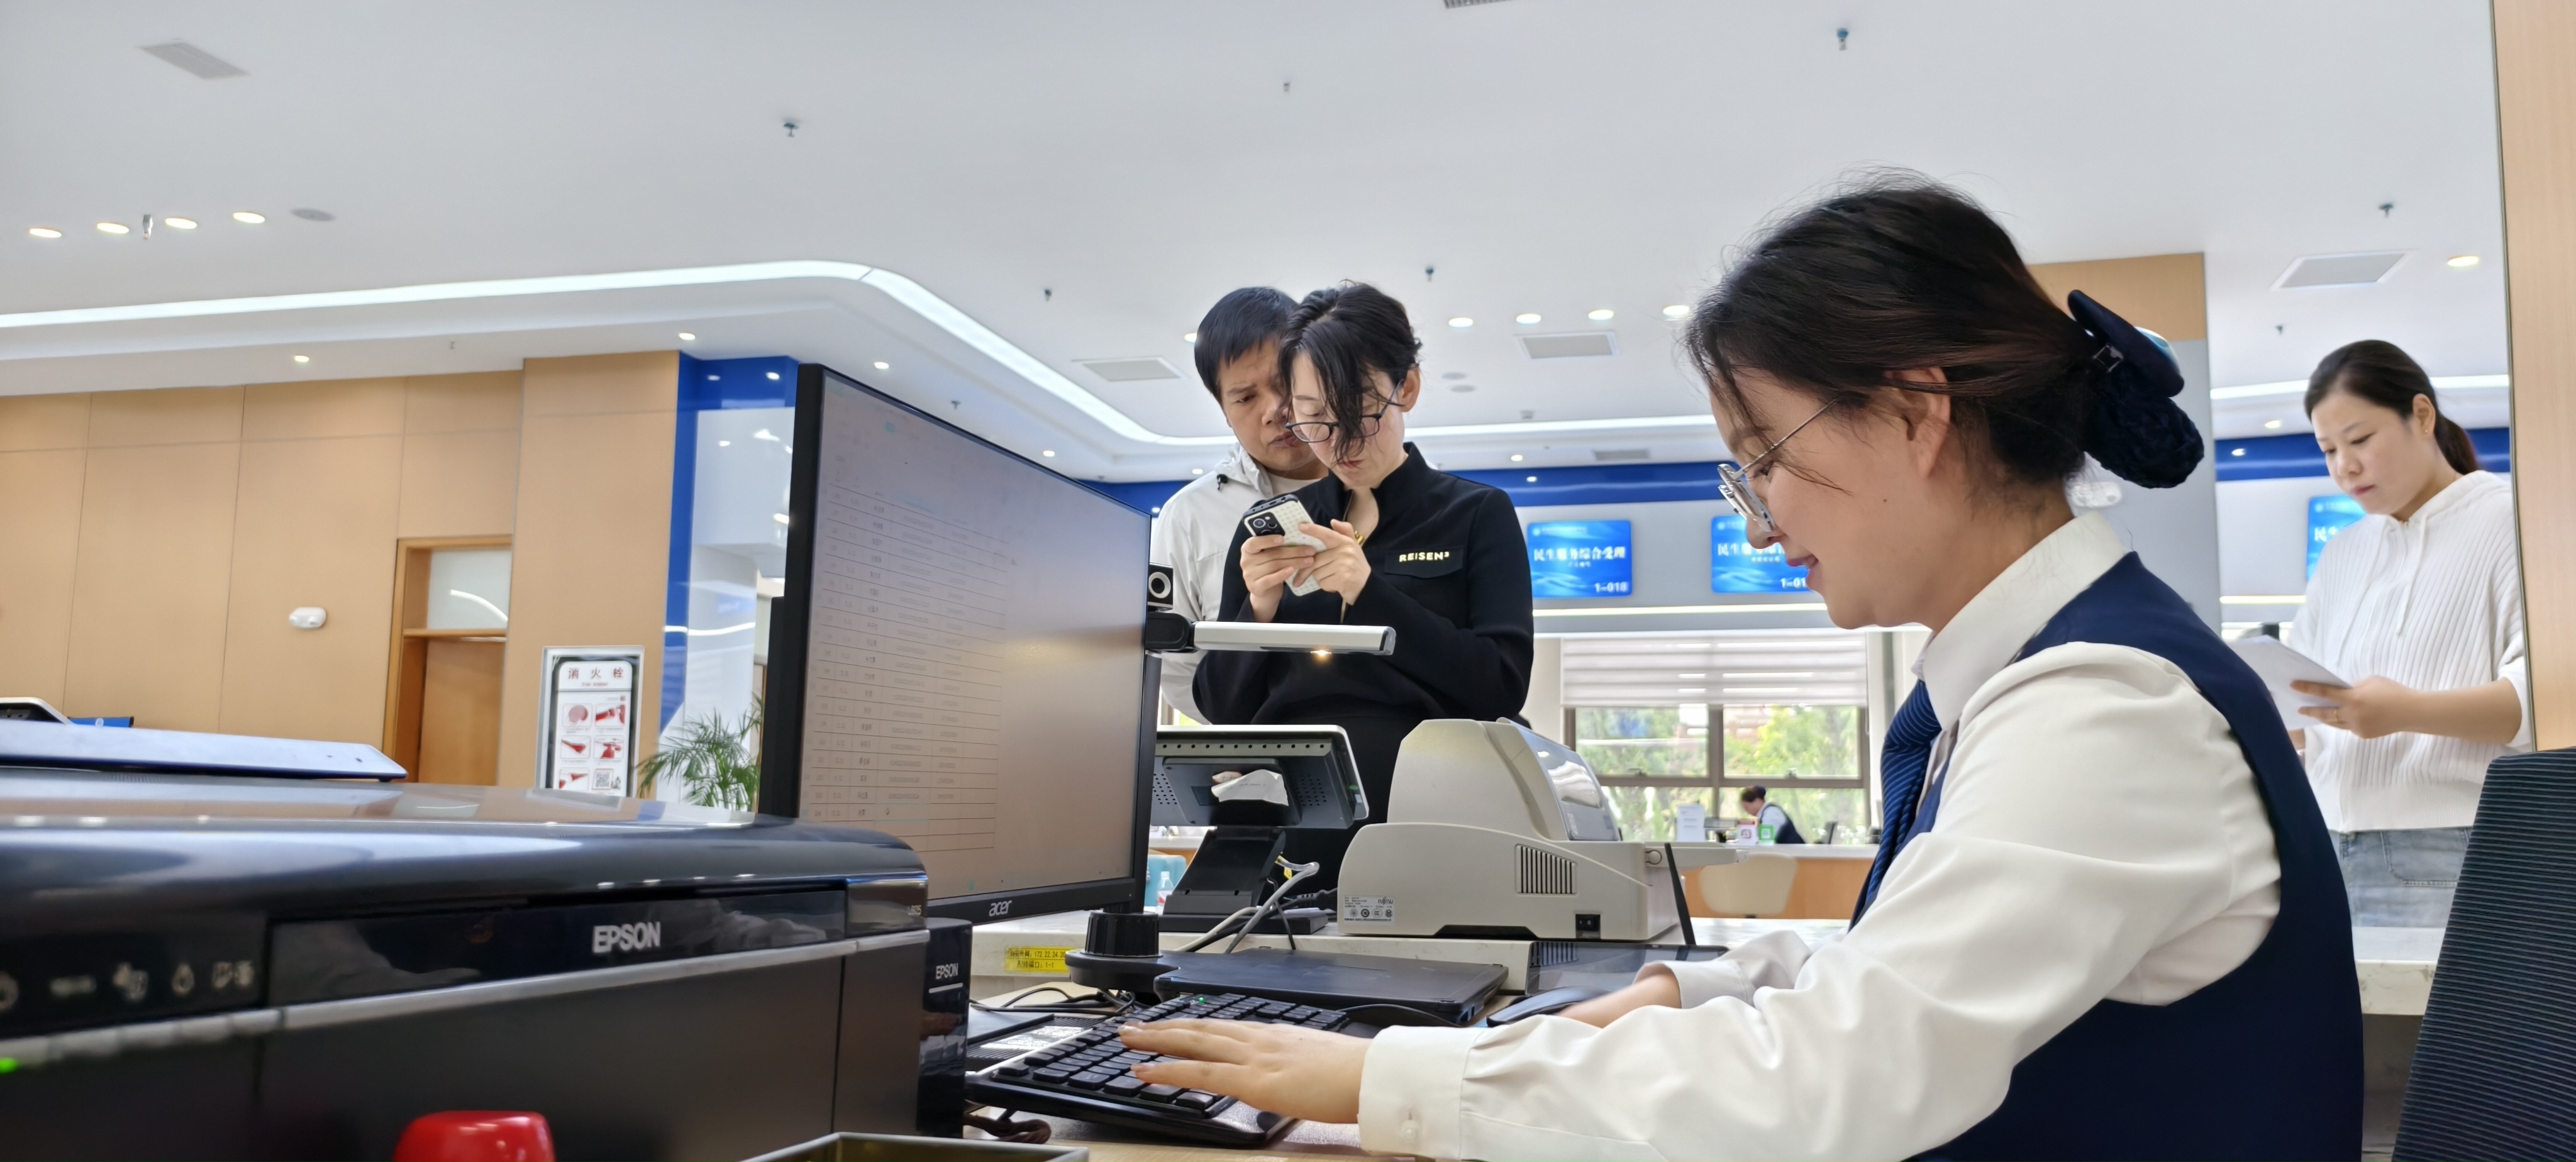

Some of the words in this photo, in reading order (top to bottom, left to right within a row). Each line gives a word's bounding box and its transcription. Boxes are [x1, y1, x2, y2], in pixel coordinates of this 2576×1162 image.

[568, 667, 624, 679] 消火栓
[989, 900, 1013, 917] acer
[1378, 896, 1394, 905] FUJITSU
[593, 921, 661, 953] EPSON
[936, 963, 959, 980] EPSON
